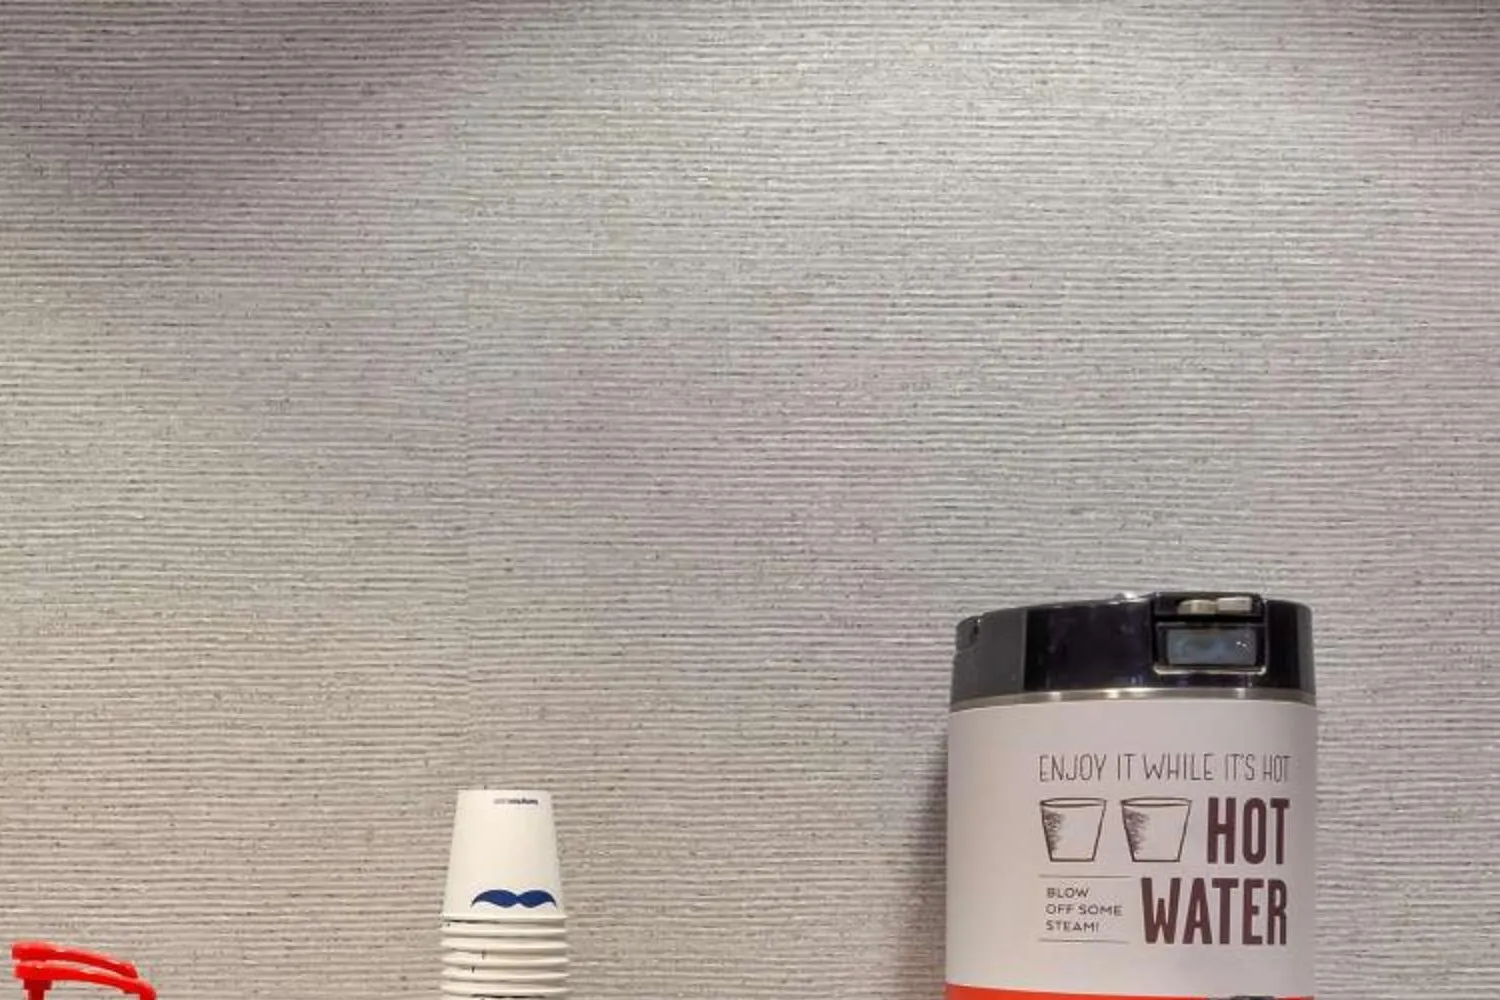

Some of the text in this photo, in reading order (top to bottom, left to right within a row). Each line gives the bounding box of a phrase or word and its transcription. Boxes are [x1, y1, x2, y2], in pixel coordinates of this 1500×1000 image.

[1039, 753, 1291, 783] ENJOY IT WHILE IT'S HOT
[1206, 796, 1291, 865] HOT
[1046, 887, 1090, 899] BLOW
[1045, 904, 1123, 916] OFF SOME
[1141, 876, 1288, 945] WATER
[1045, 920, 1100, 932] STEAM!
